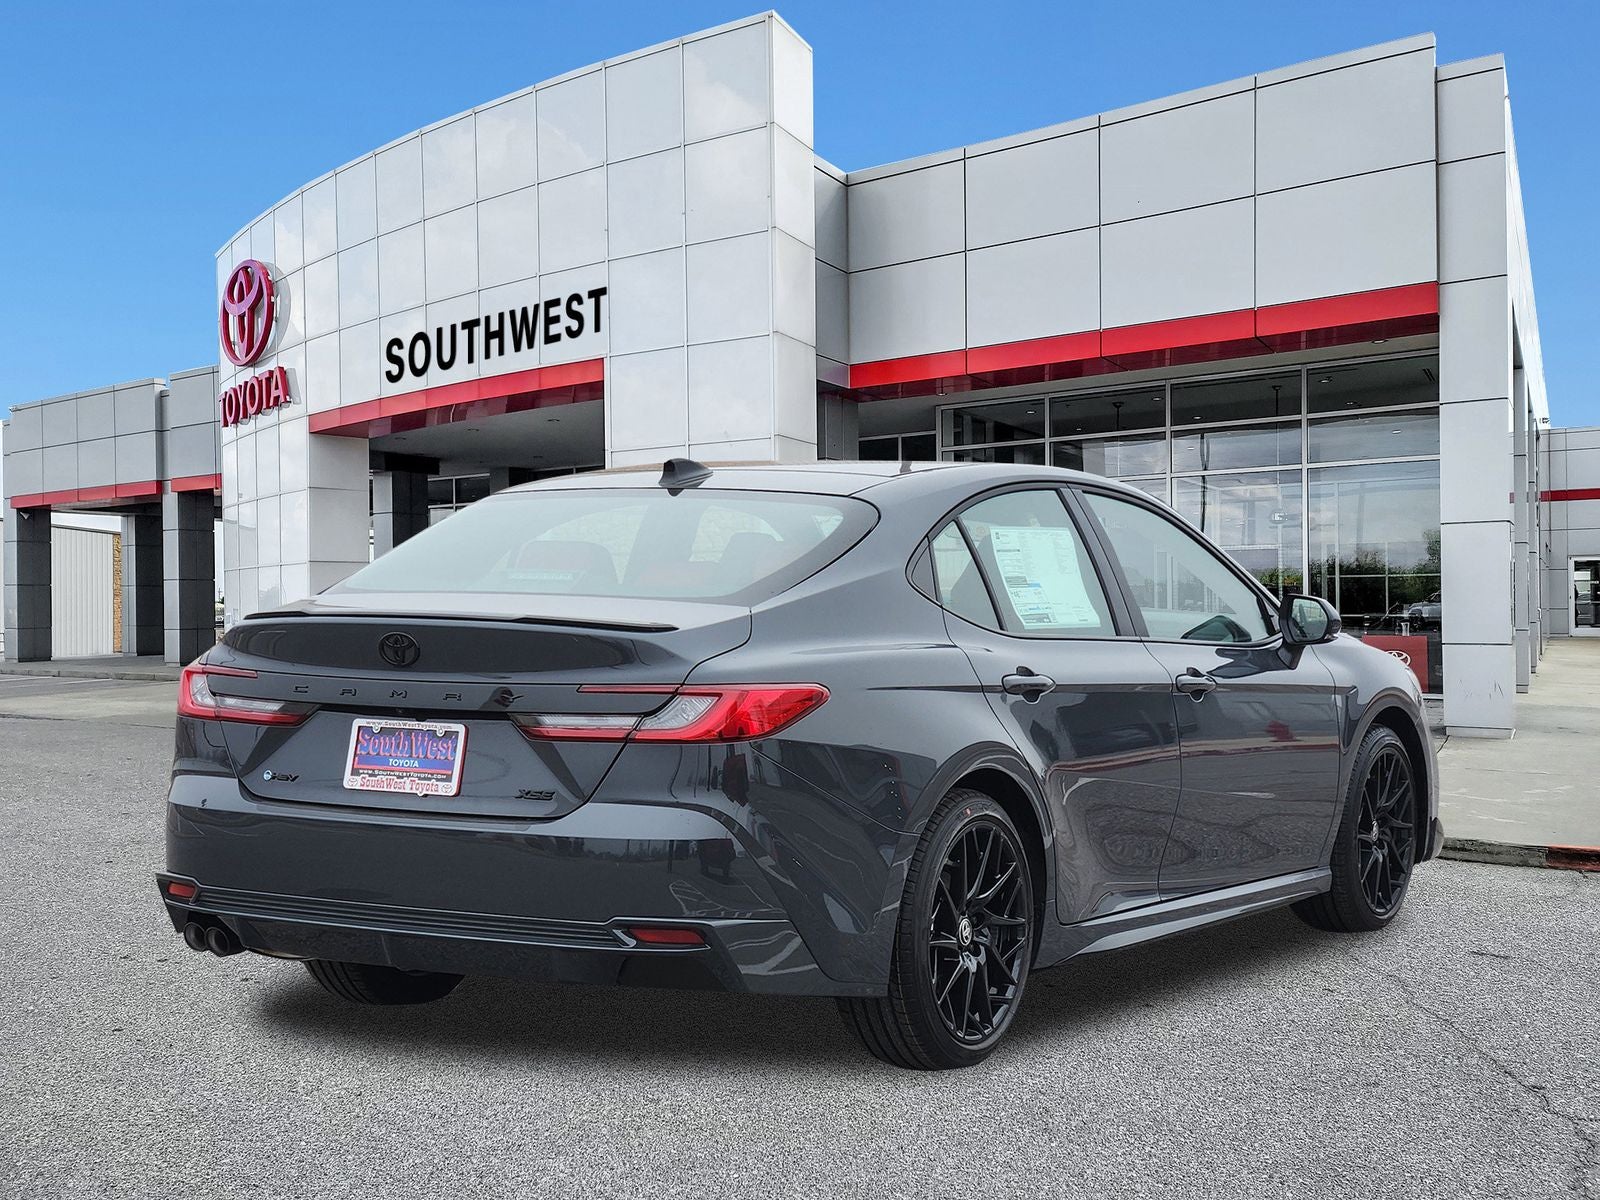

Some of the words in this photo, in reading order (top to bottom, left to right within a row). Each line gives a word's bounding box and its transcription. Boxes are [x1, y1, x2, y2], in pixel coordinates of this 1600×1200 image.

[385, 286, 607, 384] SOUTHWEST
[218, 366, 291, 428] TOYOTA
[388, 759, 419, 768] TOYOTA
[409, 779, 439, 793] Toyota
